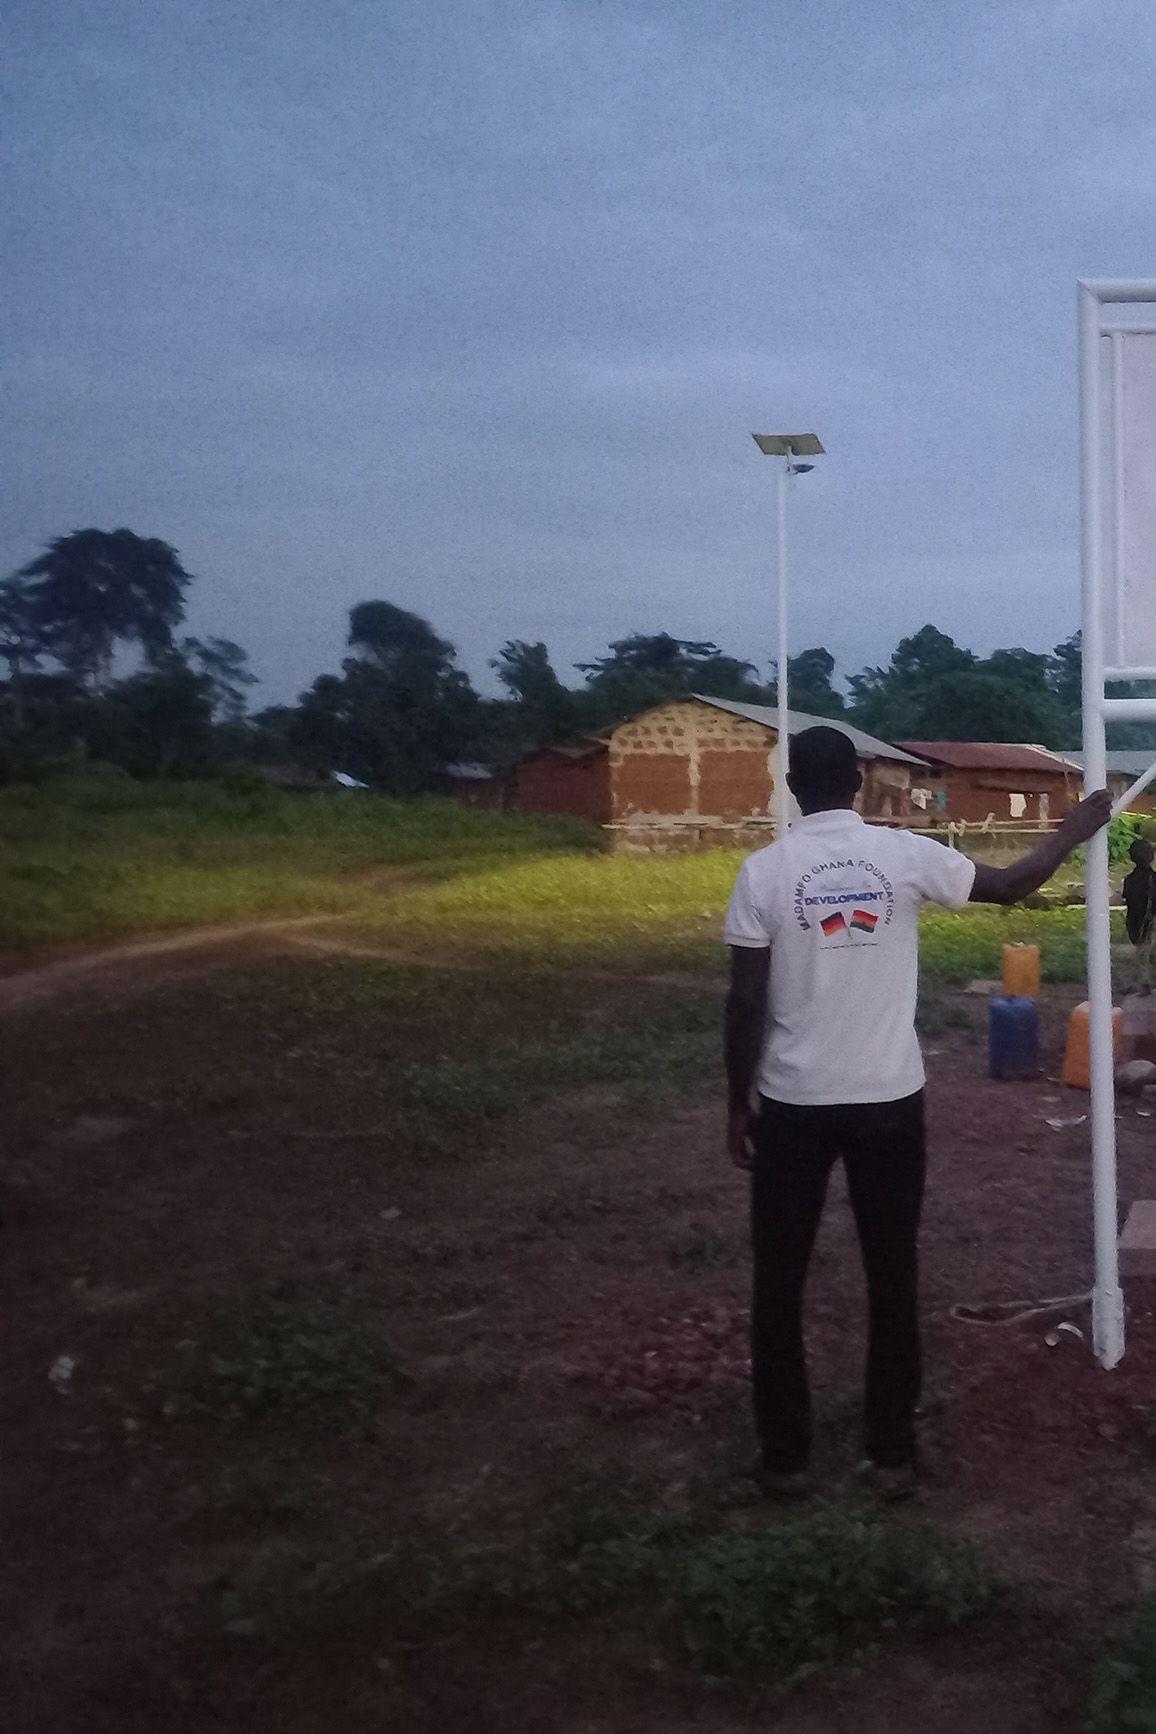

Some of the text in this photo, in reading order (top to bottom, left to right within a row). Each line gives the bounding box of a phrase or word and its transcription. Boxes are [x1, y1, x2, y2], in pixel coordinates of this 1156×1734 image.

[793, 859, 895, 931] MADAMFO GHANA FOUNDATION
[804, 891, 884, 906] DEVELOPMENT
